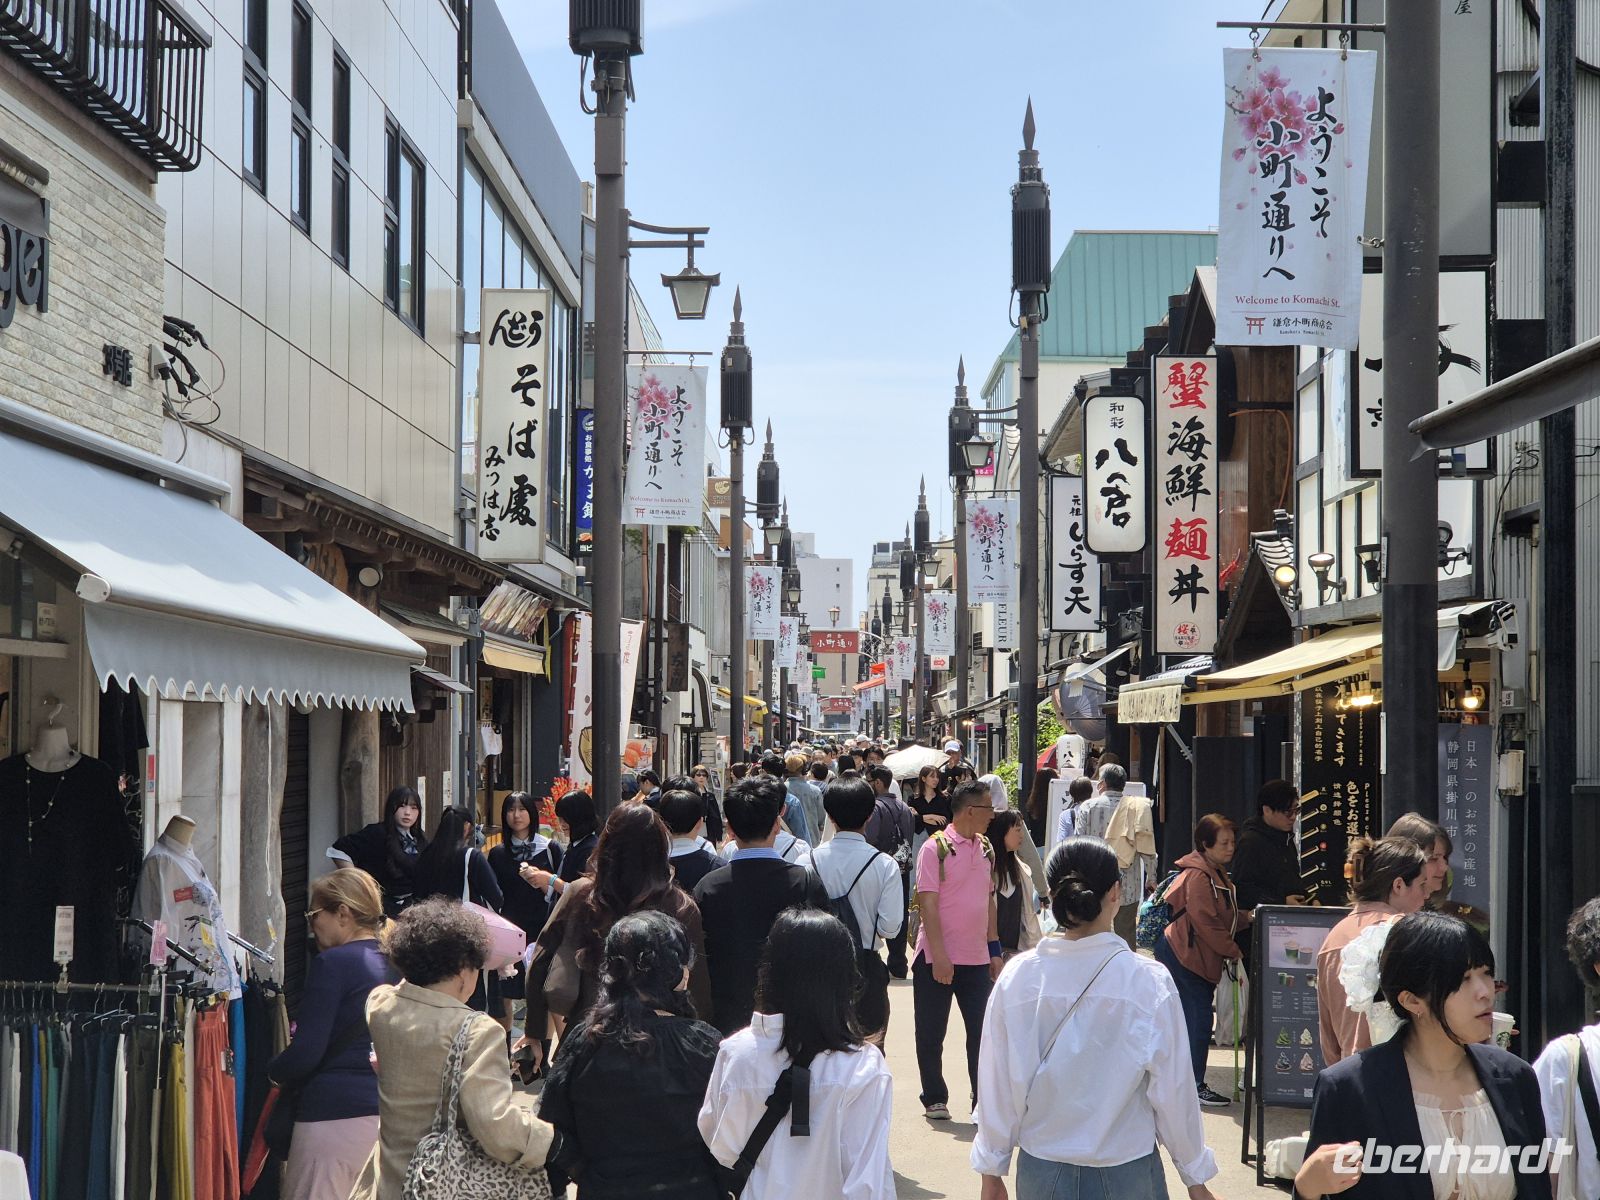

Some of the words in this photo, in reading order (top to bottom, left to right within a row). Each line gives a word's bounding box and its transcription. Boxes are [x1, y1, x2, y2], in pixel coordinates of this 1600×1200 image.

[1306, 86, 1338, 238] ようこそ
[1256, 120, 1301, 281] 小町通りへ
[1235, 295, 1278, 305] Welcome
[1280, 296, 1290, 304] to
[1292, 295, 1330, 306] Komachi
[669, 385, 689, 467] ようこそ
[1109, 401, 1126, 429] 和彩
[642, 403, 668, 490] 小町通りへ
[1069, 494, 1083, 516] 元祖
[977, 524, 995, 581] 小町通りへ
[995, 511, 1006, 566] ようこそ
[816, 638, 853, 648] 小町通り
[998, 603, 1007, 642] FLEUR
[1445, 740, 1460, 838] 静岡県掛川市
[1463, 740, 1478, 887] 日本一のお茶の産地
